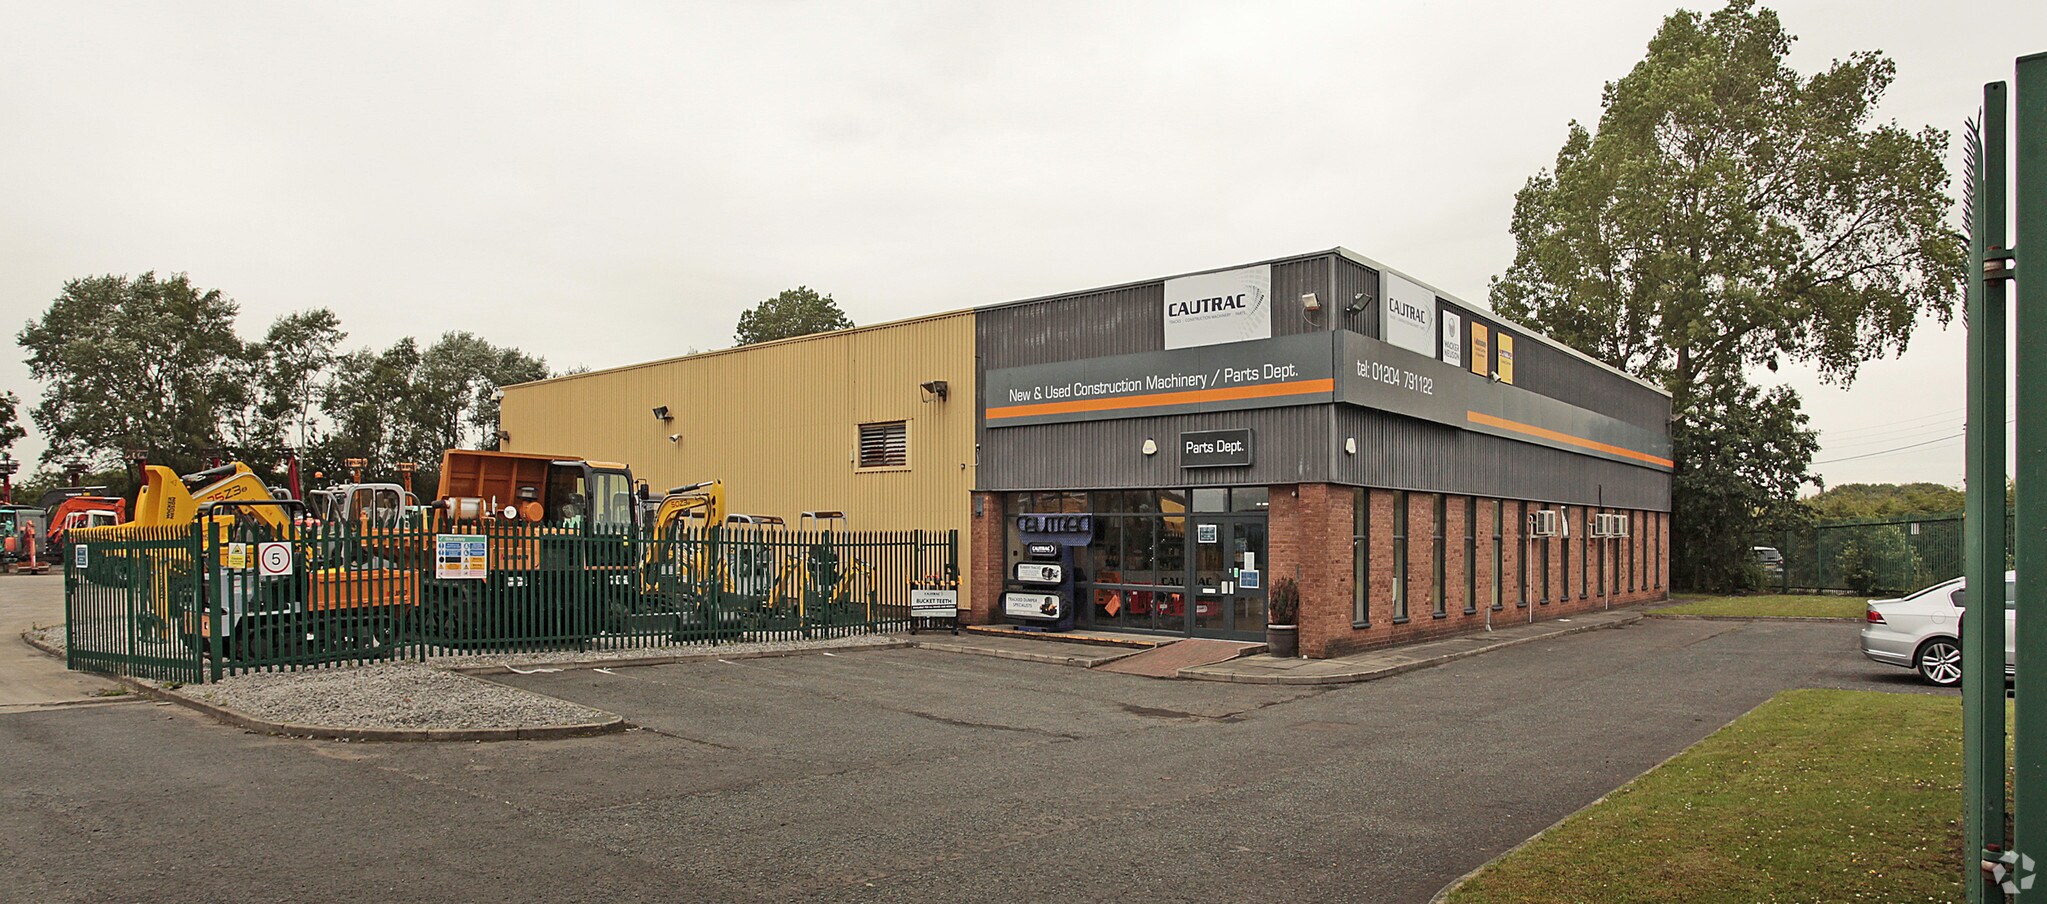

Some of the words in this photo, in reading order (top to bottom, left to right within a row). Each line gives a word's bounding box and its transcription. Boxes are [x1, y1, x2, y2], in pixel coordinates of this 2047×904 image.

[1168, 294, 1246, 317] CAUTRAC
[1389, 297, 1425, 324] CAUTRAC
[1009, 389, 1031, 402] New
[1033, 386, 1042, 400] &
[1045, 384, 1071, 399] Used
[1073, 378, 1142, 396] Construction
[1146, 373, 1207, 390] Machinery
[1211, 369, 1221, 387] /
[1224, 367, 1259, 383] Parts
[1263, 363, 1299, 382] Dept.
[1357, 360, 1370, 378] tel:
[1372, 362, 1400, 387] 01204
[1403, 371, 1433, 395] 791122
[1186, 441, 1214, 454] Parts
[1216, 439, 1245, 455] Dept.
[271, 553, 281, 566] 5
